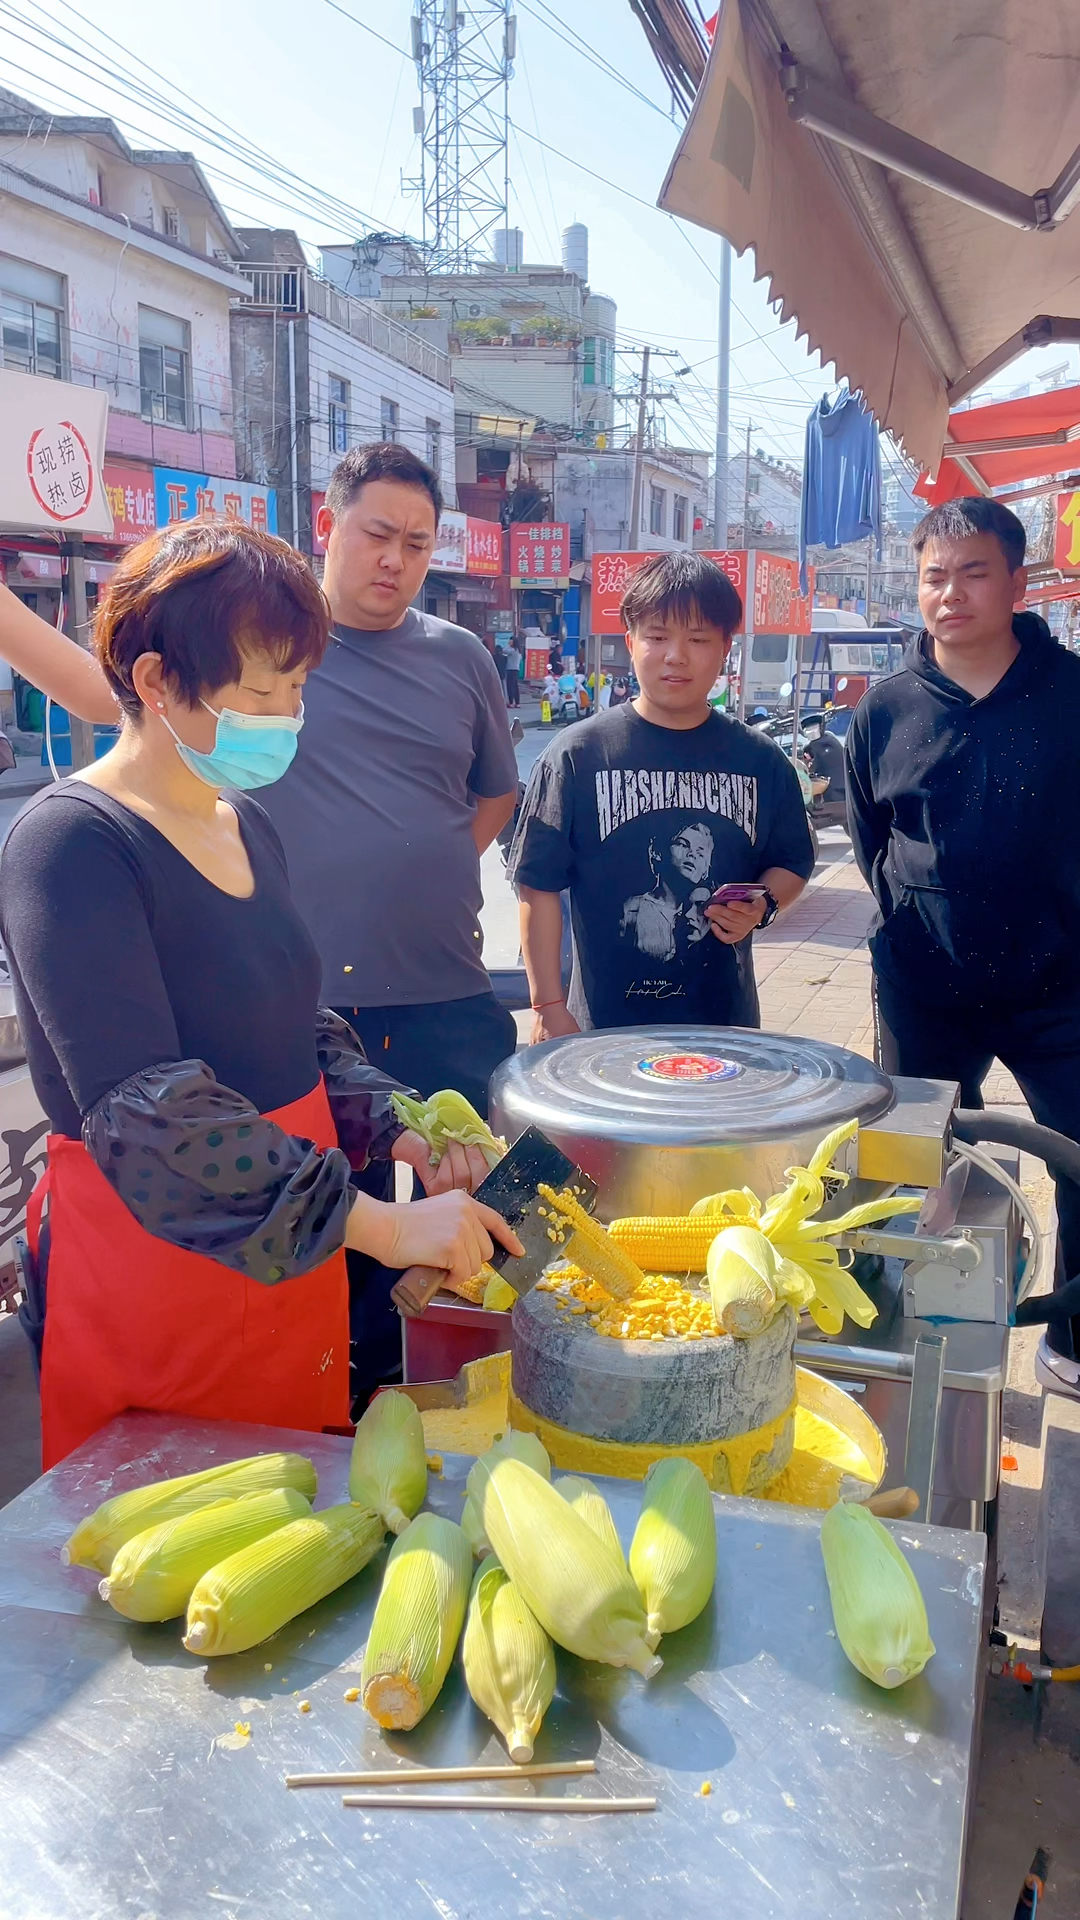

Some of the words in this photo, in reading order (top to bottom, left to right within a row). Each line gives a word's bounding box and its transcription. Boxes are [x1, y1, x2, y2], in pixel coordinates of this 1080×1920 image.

[36, 435, 75, 474] 现捞
[47, 471, 86, 511] 热卤
[516, 527, 563, 540] 一佳排档
[518, 545, 529, 573] 火锅
